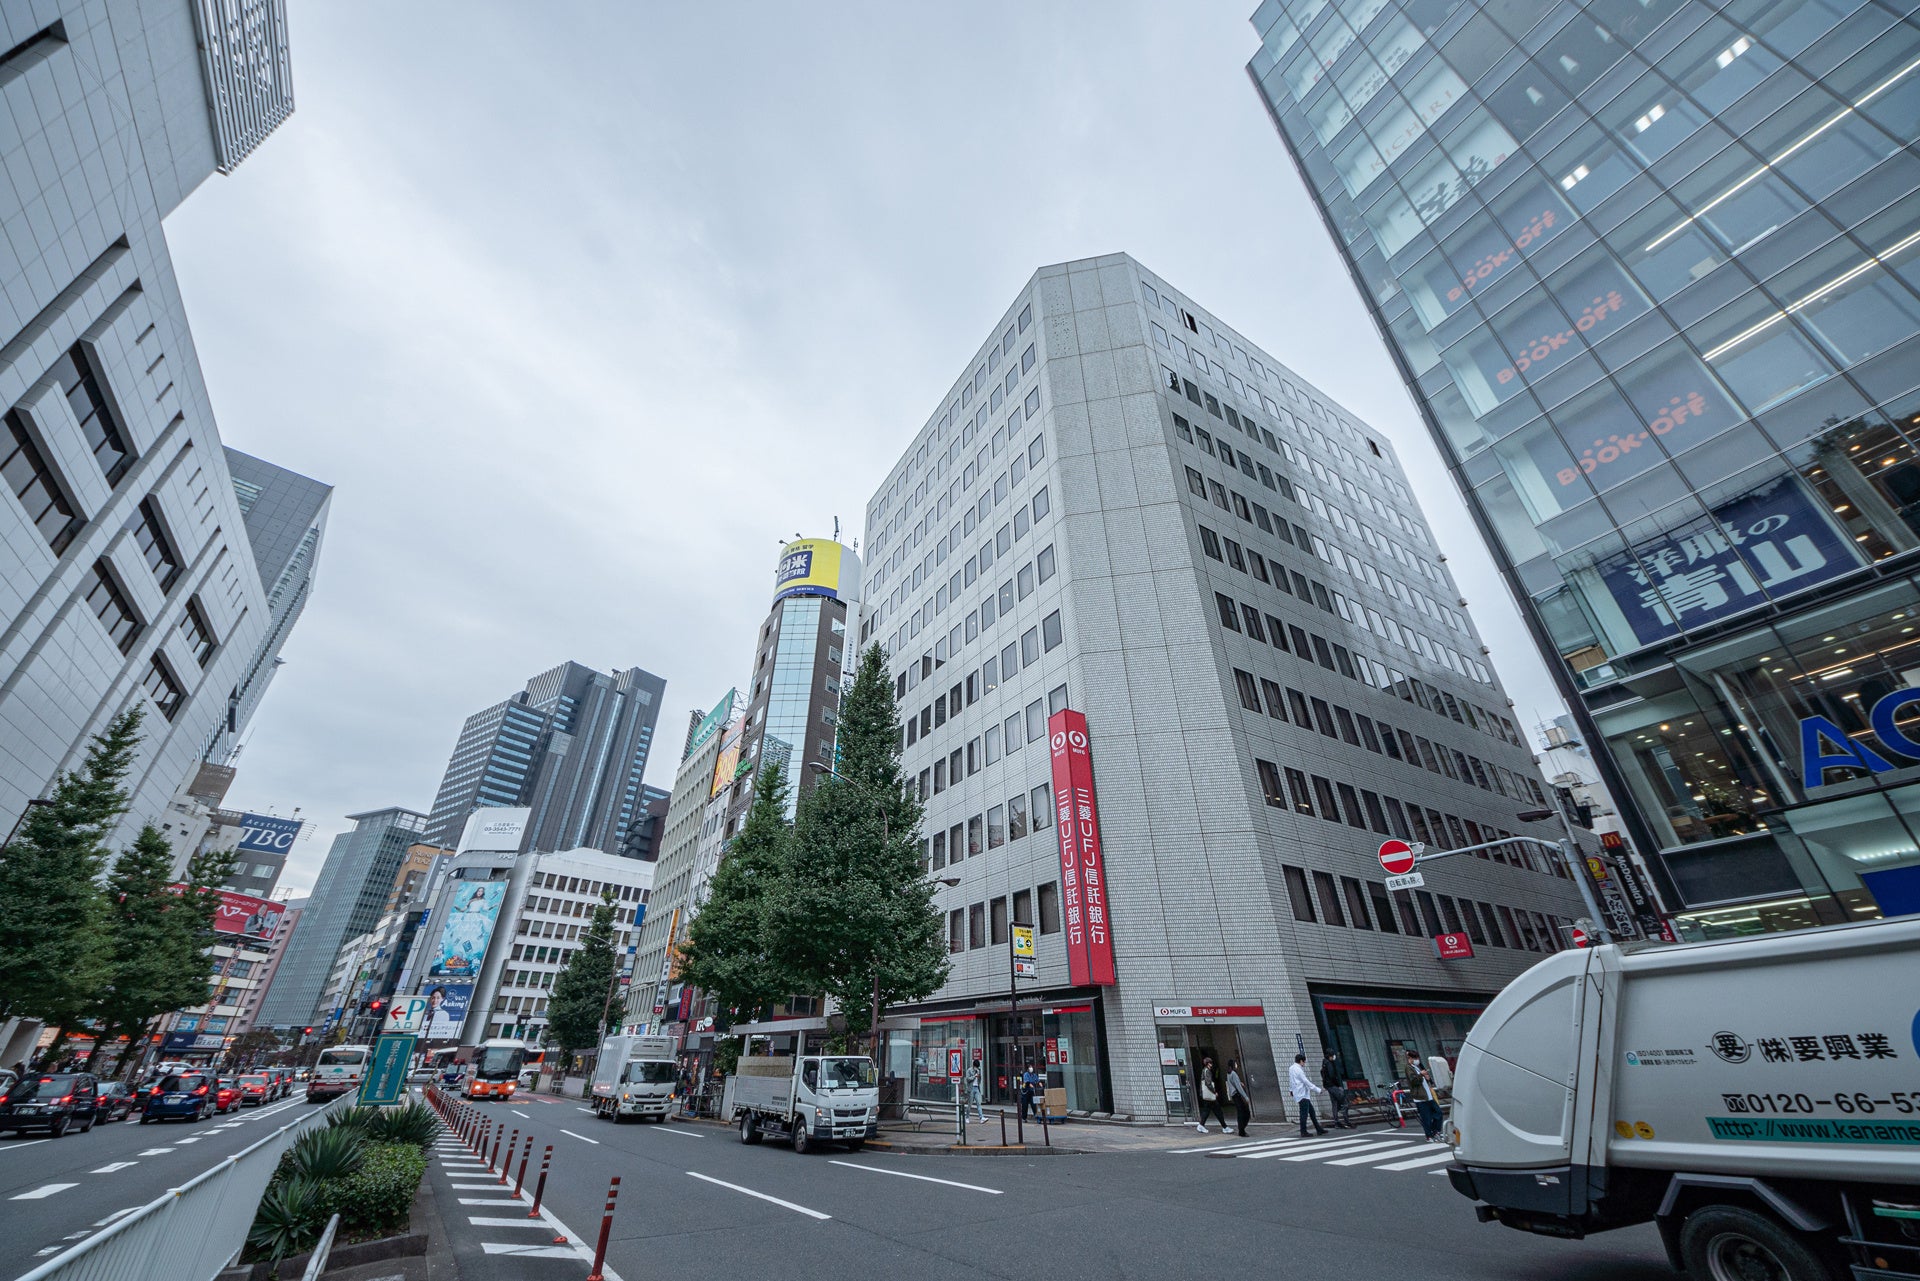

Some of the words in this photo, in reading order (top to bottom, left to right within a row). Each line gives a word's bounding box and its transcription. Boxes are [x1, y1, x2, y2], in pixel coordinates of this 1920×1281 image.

[1447, 210, 1556, 302] BOOK-OFF
[1496, 291, 1623, 385] BOOK-OFF
[1556, 392, 1705, 487] BOOK-OFF
[1625, 513, 1790, 587] 洋服の
[1640, 534, 1828, 627] 青山
[239, 826, 294, 849] TBC
[246, 819, 298, 831] Aesthetic
[1058, 788, 1082, 945] 三菱UFJ信託銀行
[1077, 787, 1105, 945] 三菱UFJ信託銀行
[1615, 855, 1645, 906] McDonald's
[393, 1021, 413, 1029] 入口
[405, 999, 426, 1021] P
[1715, 1034, 1745, 1058] 要
